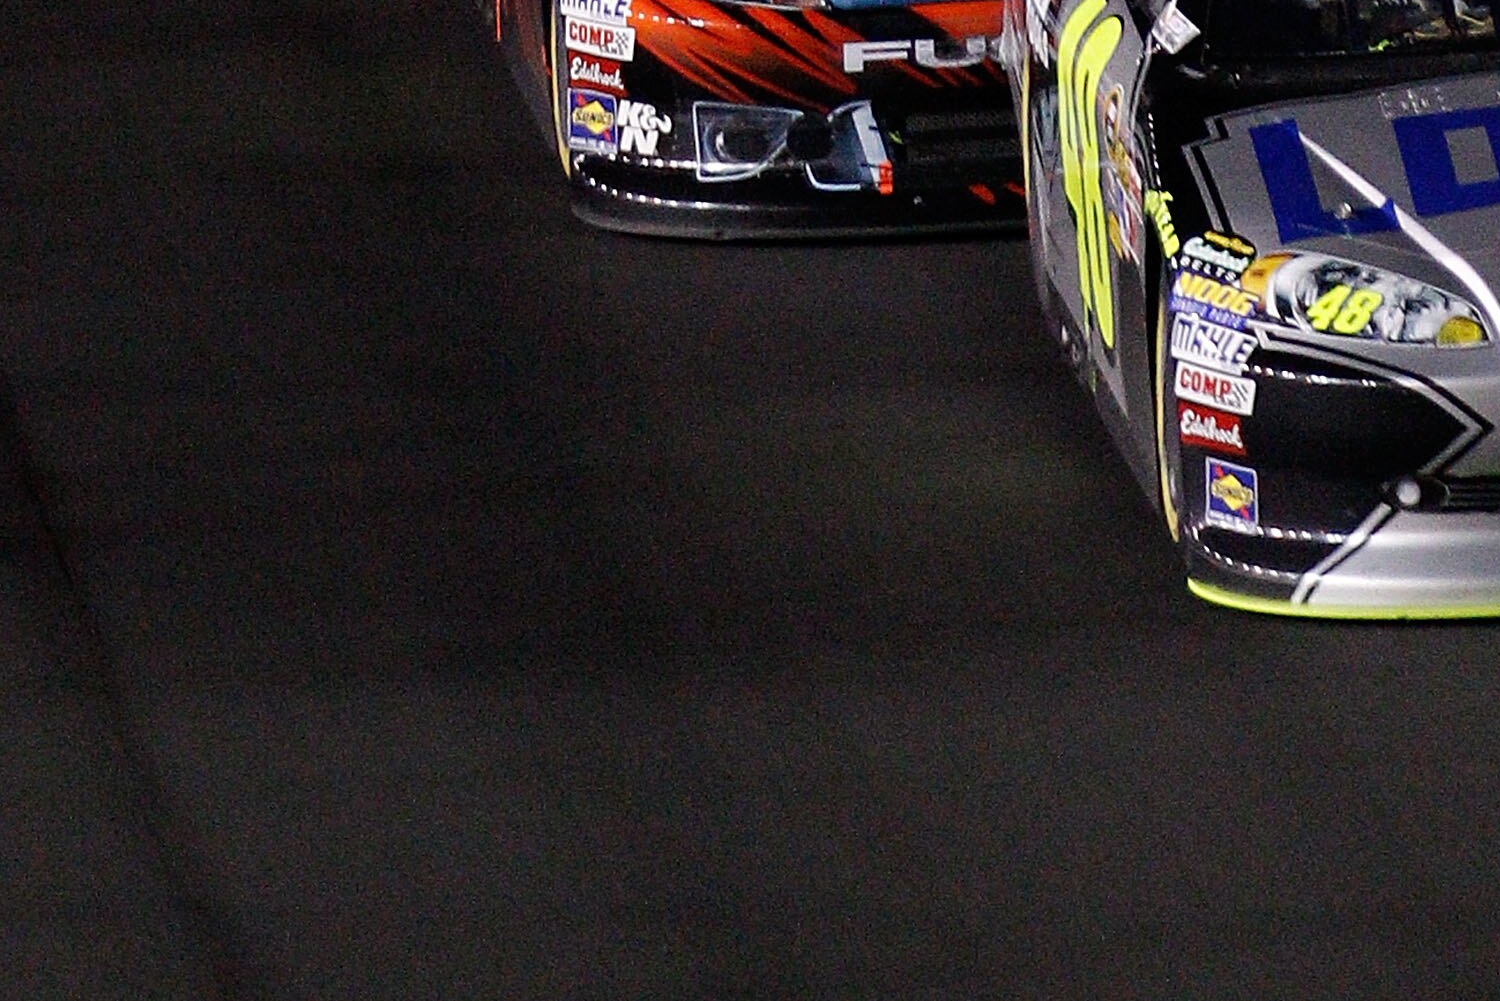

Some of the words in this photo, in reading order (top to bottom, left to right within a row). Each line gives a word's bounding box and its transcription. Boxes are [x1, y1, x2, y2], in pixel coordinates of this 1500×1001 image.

[569, 22, 615, 48] COMP
[843, 34, 1002, 75] FU
[570, 56, 625, 90] Edelbrock
[1180, 255, 1237, 281] BELTS
[1173, 270, 1260, 317] MOOG
[1307, 284, 1383, 336] 48
[1179, 366, 1233, 399] COMP
